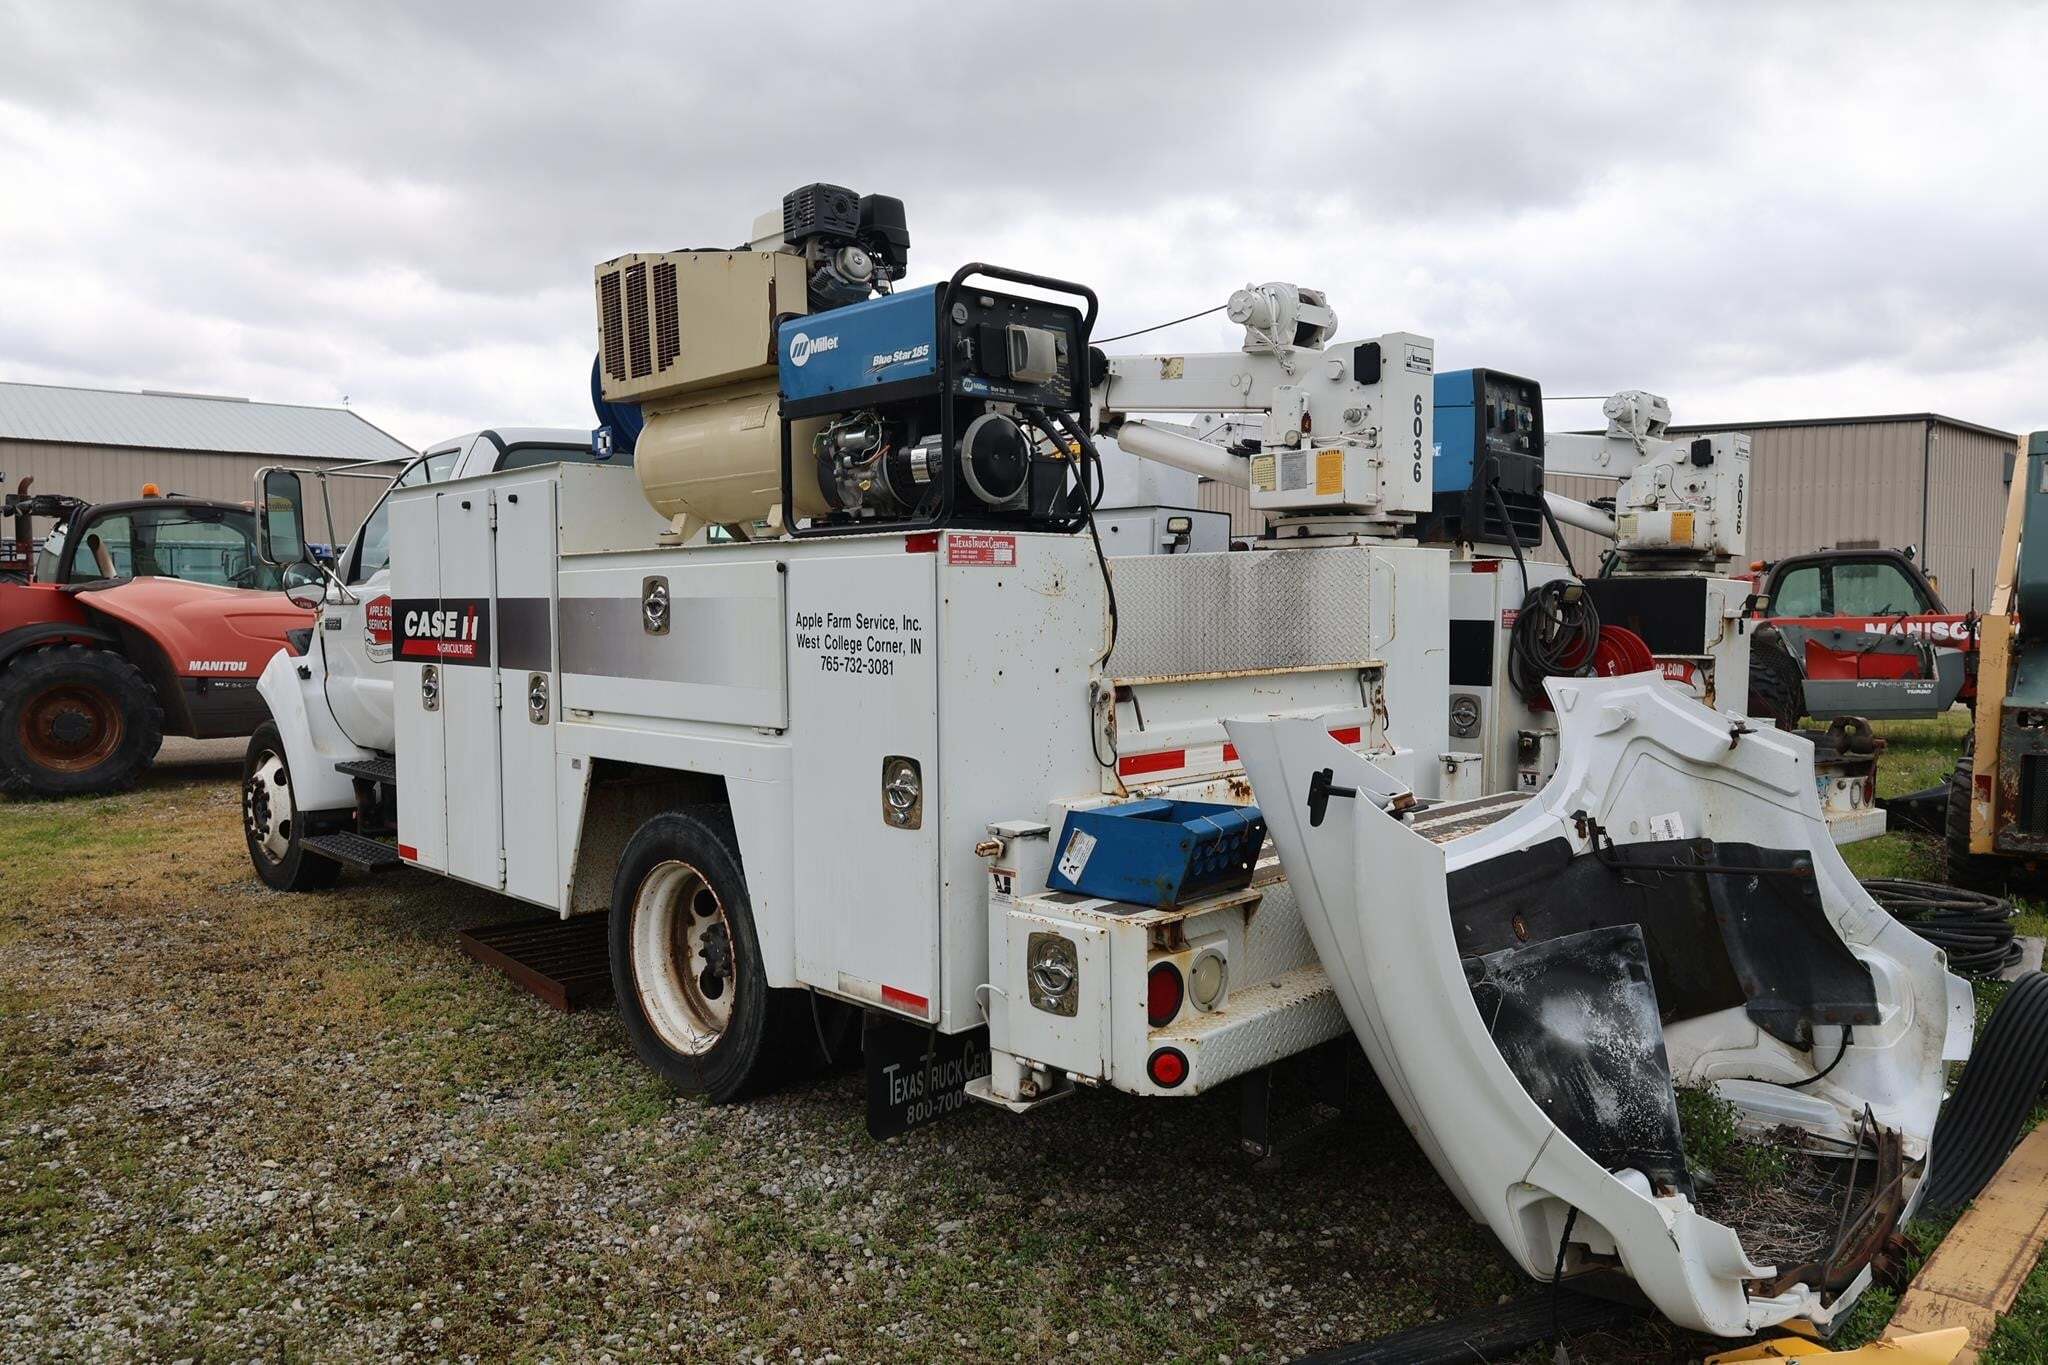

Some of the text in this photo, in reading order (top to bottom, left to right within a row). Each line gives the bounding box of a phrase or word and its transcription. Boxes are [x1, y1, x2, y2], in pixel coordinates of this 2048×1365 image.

[810, 335, 839, 354] Miller
[872, 353, 893, 366] Blue
[893, 349, 912, 363] Star
[912, 344, 929, 360] 185
[1413, 394, 1423, 483] 6036
[1736, 473, 1744, 535] 6036
[404, 610, 458, 638] CASE
[795, 611, 922, 633] Apple Farm Service, Inc.
[437, 643, 473, 654] AGRICULTURE
[796, 633, 922, 656] West College Corner, IN
[189, 660, 248, 672] MANITOU
[820, 655, 893, 676] 765-732-3081
